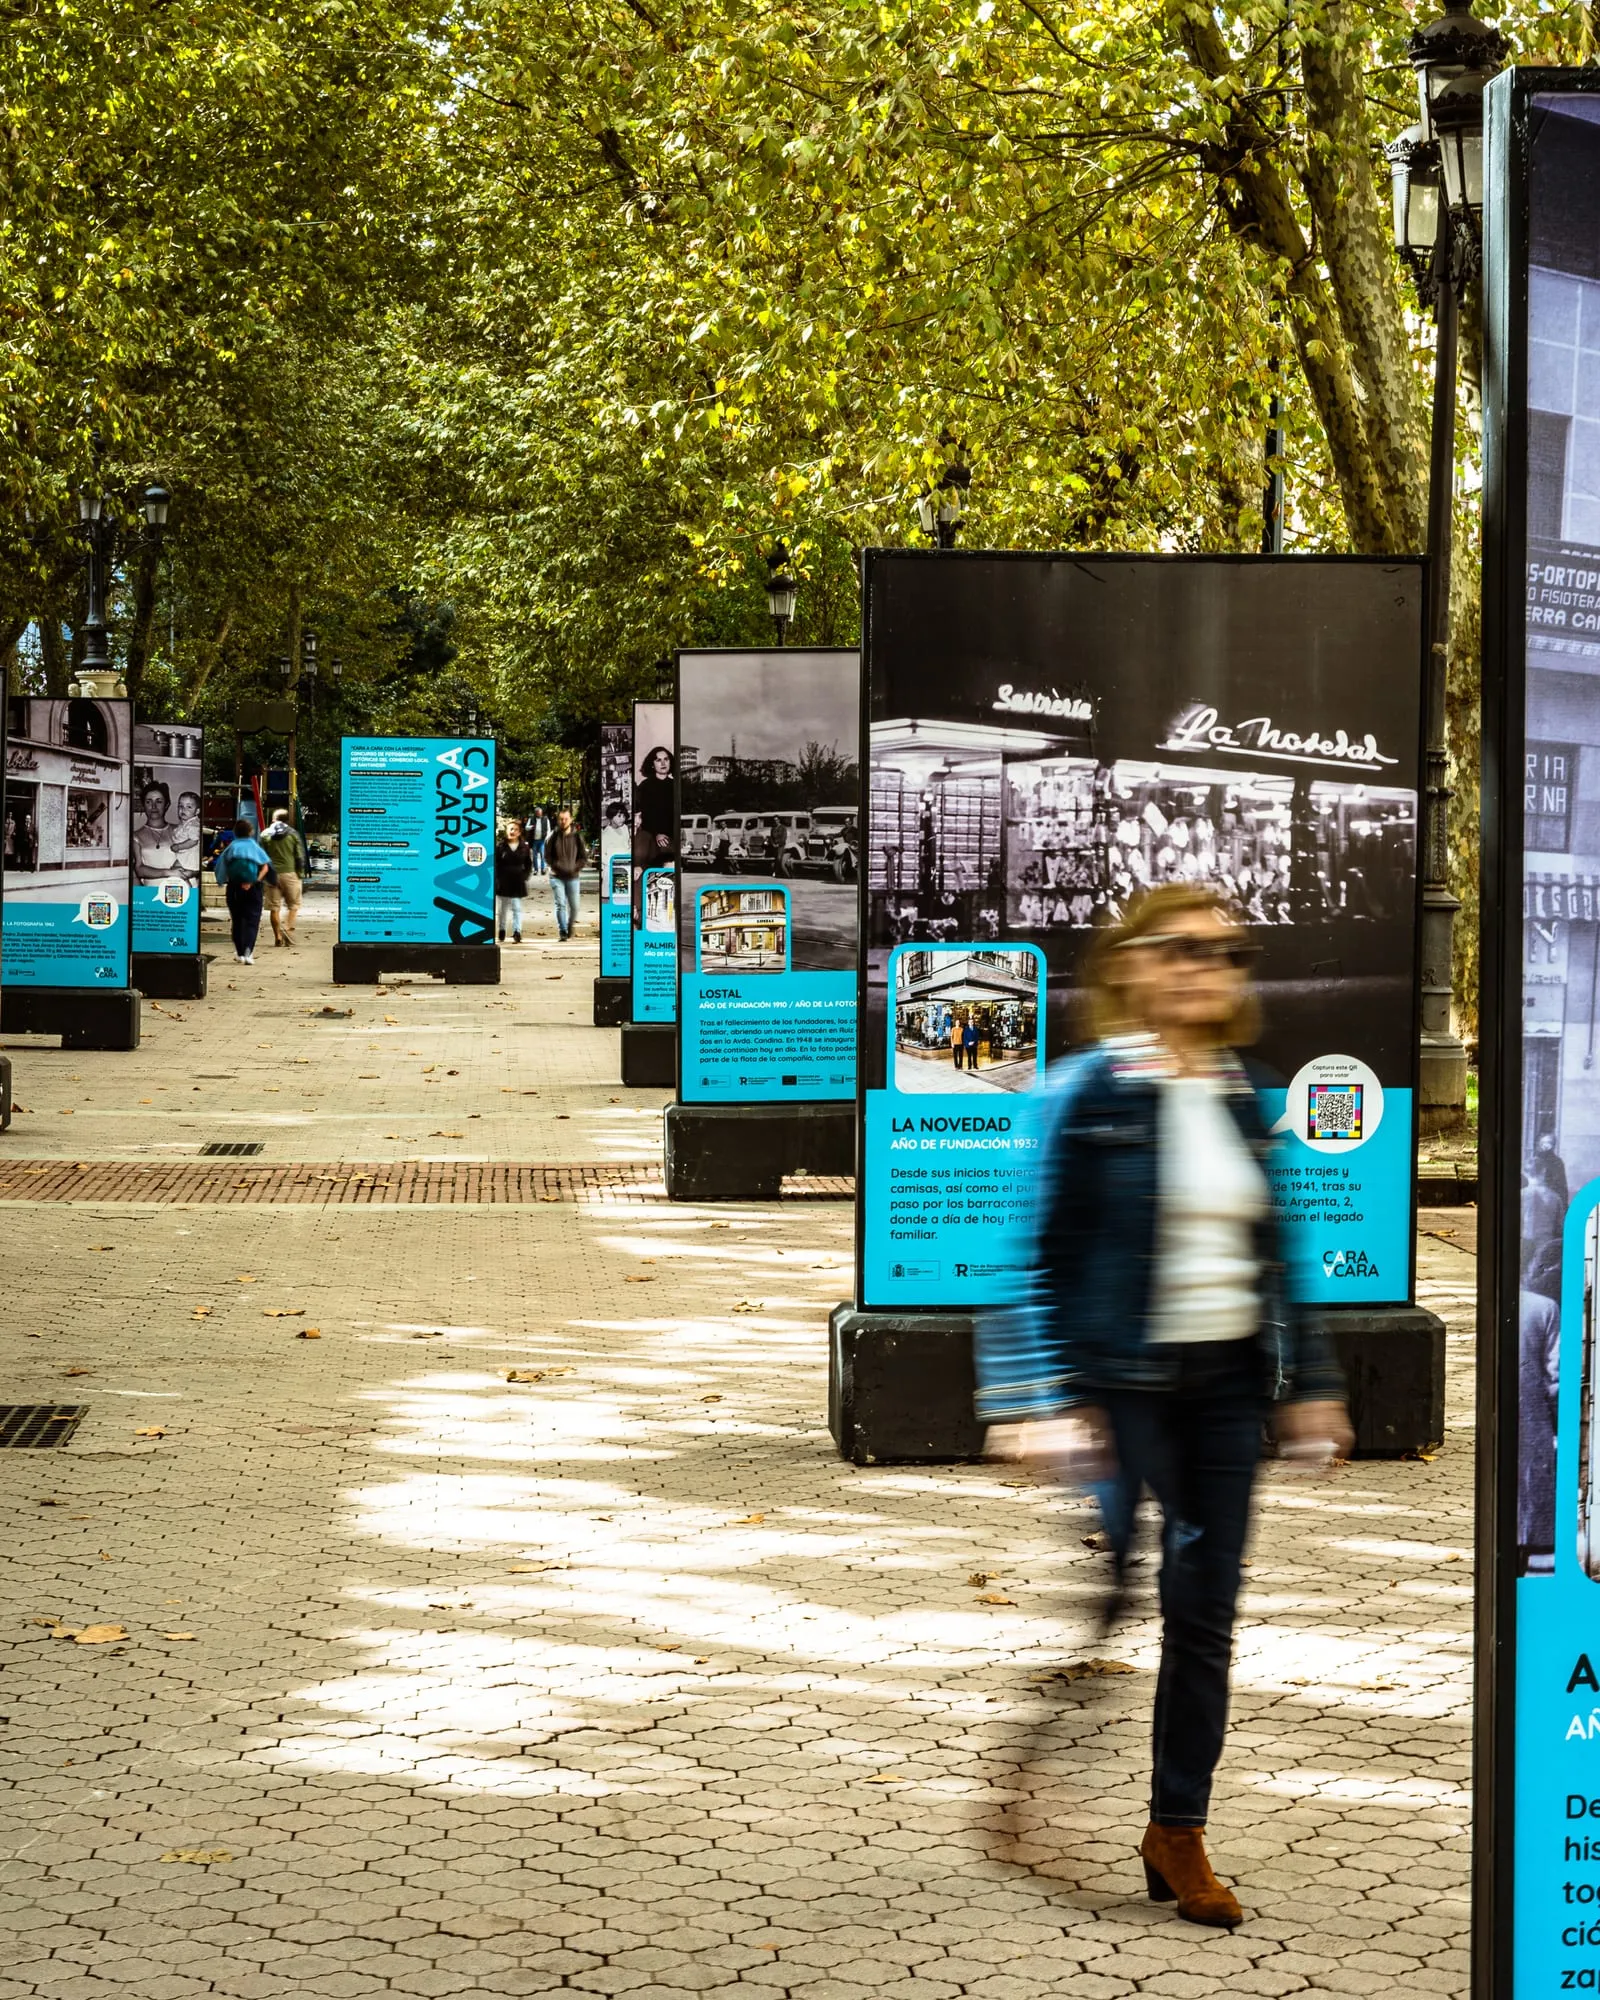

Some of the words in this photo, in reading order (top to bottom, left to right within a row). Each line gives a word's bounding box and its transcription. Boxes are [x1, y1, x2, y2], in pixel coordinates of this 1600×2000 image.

[700, 988, 742, 999] LOSTAL
[699, 1000, 716, 1009] AÑO
[728, 1000, 770, 1009] FUNDACIÓN
[795, 1000, 812, 1008] AÑO
[760, 1046, 773, 1054] hoy
[700, 1056, 719, 1064] parte
[892, 1117, 914, 1132] LA
[920, 1117, 1012, 1132] NOVEDAD
[890, 1137, 918, 1150] AÑO
[920, 1139, 936, 1150] DE
[940, 1136, 1010, 1150] FUNDACIÓN
[1014, 1138, 1039, 1149] 1932
[890, 1168, 928, 1178] Desde
[930, 1170, 950, 1178] sus
[954, 1168, 990, 1178] inicios
[1305, 1166, 1338, 1178] trajes
[1342, 1168, 1349, 1178] y
[890, 1184, 942, 1194] camisas,
[946, 1183, 963, 1194] así
[966, 1185, 998, 1194] como
[1002, 1182, 1012, 1192] el
[1272, 1182, 1287, 1192] de
[1291, 1181, 1318, 1193] 1941,
[1322, 1182, 1345, 1192] tras
[1348, 1182, 1362, 1192] su
[890, 1200, 919, 1211] paso
[922, 1200, 943, 1211] por
[947, 1198, 964, 1209] los
[967, 1198, 1036, 1209] barracones
[1290, 1197, 1340, 1208] Argenta,
[1344, 1196, 1354, 1208] 2,
[890, 1214, 927, 1224] donde
[942, 1214, 961, 1224] día
[964, 1214, 978, 1224] de
[982, 1214, 1004, 1226] hoy
[1310, 1212, 1320, 1222] el
[1324, 1212, 1364, 1224] legado
[890, 1229, 938, 1240] familiar.
[1322, 1250, 1368, 1264] CARA
